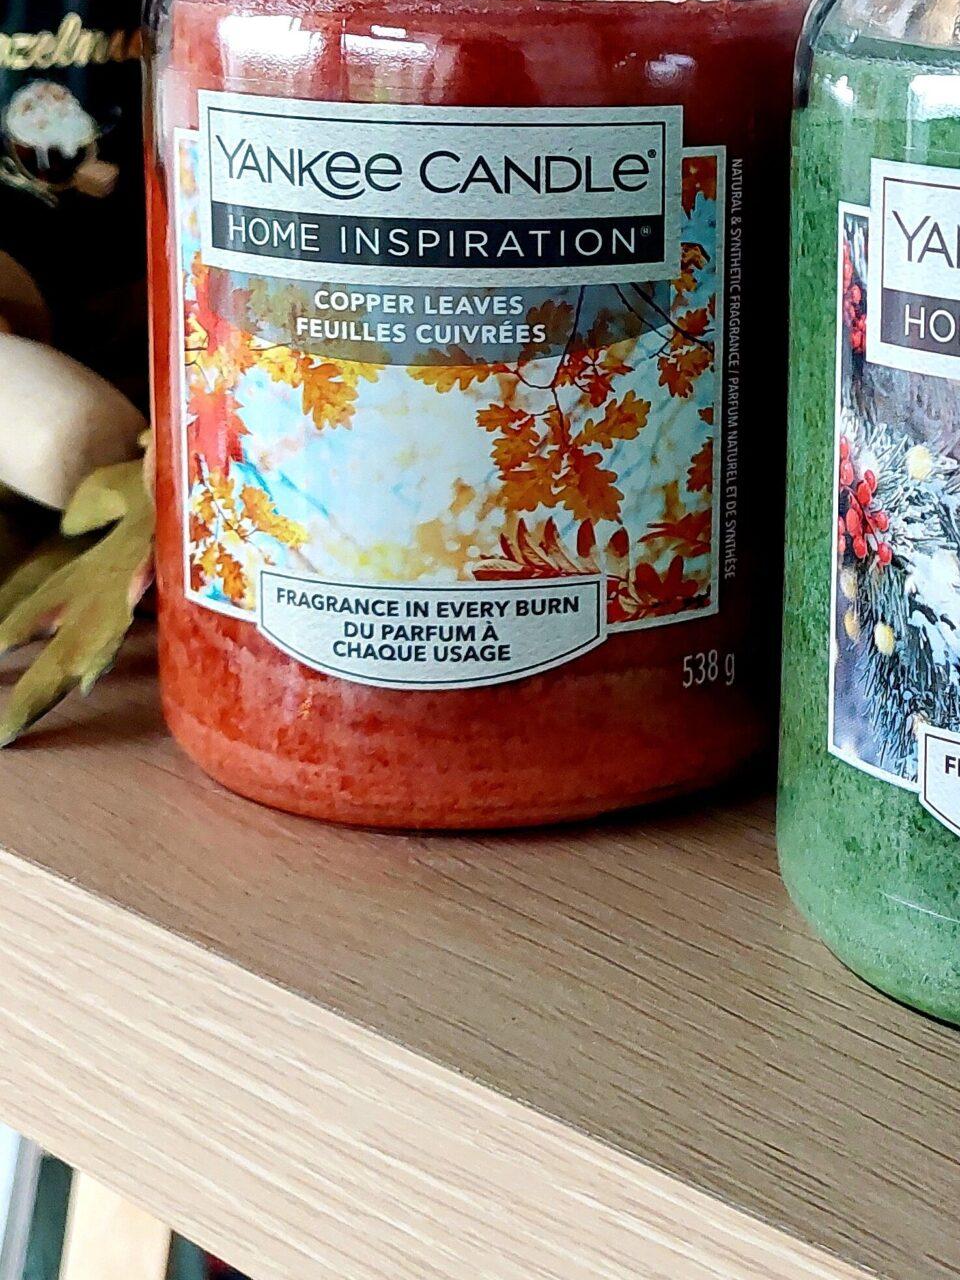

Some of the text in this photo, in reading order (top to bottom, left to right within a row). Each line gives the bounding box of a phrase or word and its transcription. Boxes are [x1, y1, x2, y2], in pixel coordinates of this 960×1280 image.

[730, 158, 744, 214] NATURAL
[228, 214, 320, 252] HOME
[730, 216, 742, 226] &
[729, 228, 742, 293] SYNTHETIC
[314, 290, 524, 316] COPPER LEAVES
[296, 318, 547, 345] FEUILLES CUIVRÉES
[728, 295, 741, 367] FRAGRANCE
[276, 587, 580, 618] FRAGRANCE IN EVERY BURN
[343, 621, 500, 642] DU PARFUM À
[332, 640, 512, 663] CHAQUE USAGE
[682, 648, 735, 689] 538 g
